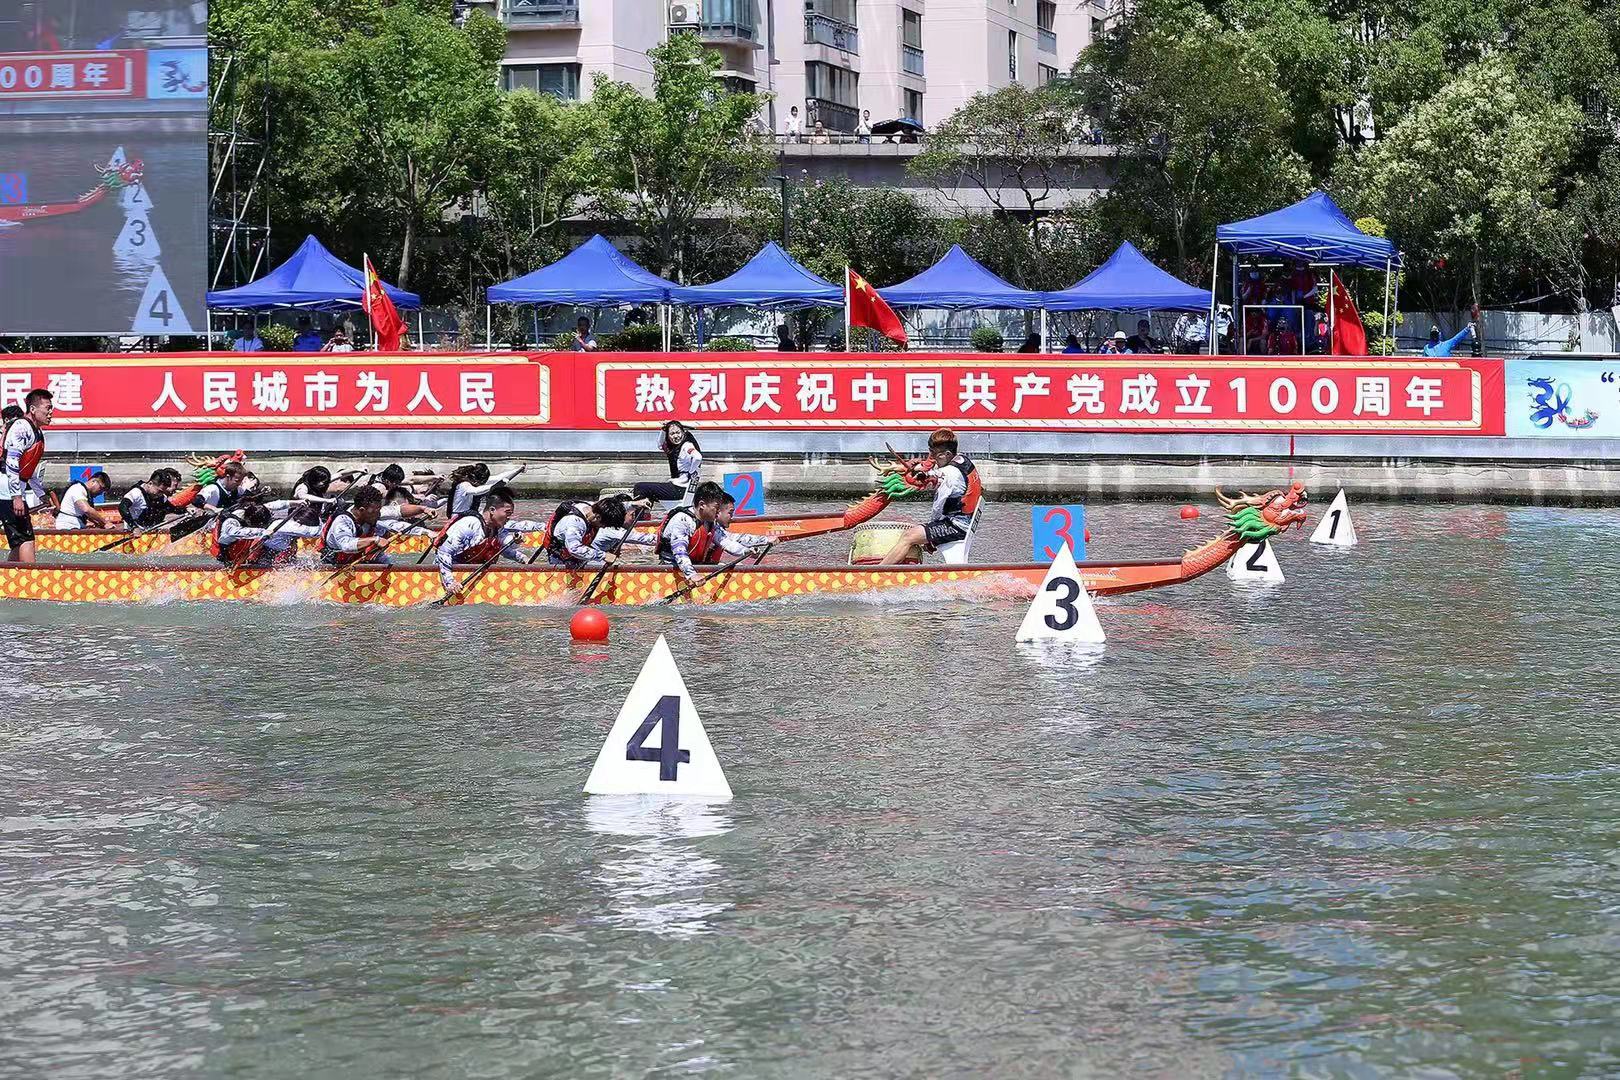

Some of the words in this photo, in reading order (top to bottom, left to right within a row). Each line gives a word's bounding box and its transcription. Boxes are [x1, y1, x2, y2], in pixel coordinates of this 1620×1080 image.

[0, 62, 109, 89] 00周年
[129, 219, 147, 247] 3
[149, 290, 173, 327] 4
[150, 370, 496, 414] 人民城市为人民
[634, 371, 1446, 417] 热烈庆祝中国共产党成立100周年
[731, 473, 758, 516] 2
[1043, 508, 1075, 561] 3
[1328, 509, 1342, 539] 1
[1246, 540, 1268, 572] 2
[1045, 576, 1080, 630] 3
[627, 695, 690, 782] 4
